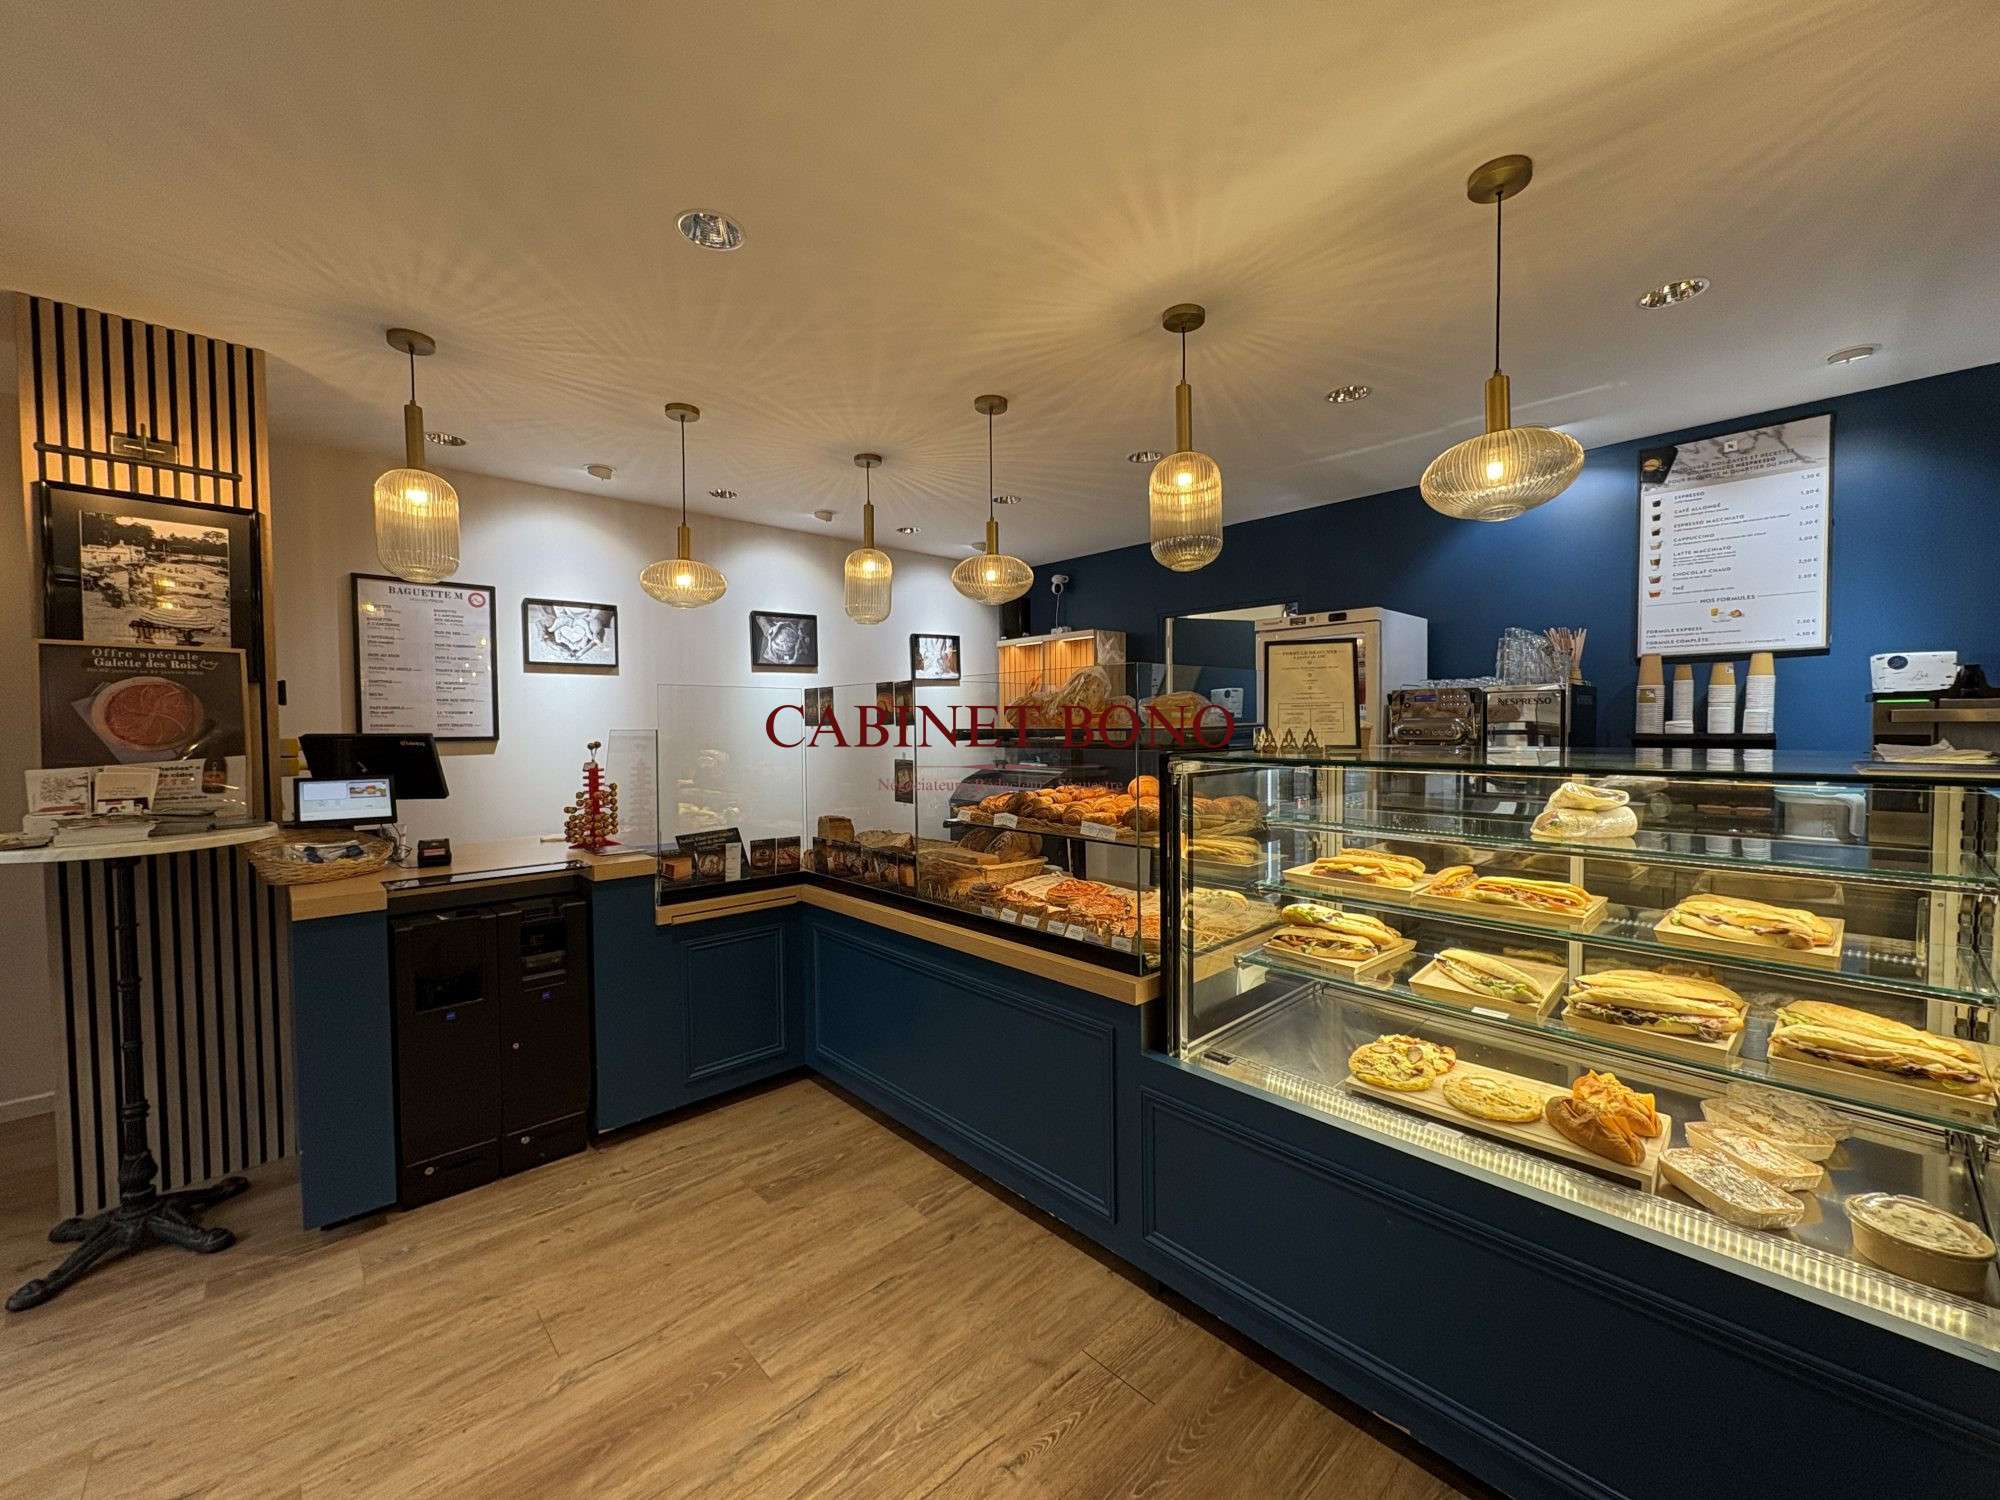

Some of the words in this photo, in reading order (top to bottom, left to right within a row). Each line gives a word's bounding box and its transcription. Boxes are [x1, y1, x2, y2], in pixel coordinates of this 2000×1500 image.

[388, 585, 452, 599] BAGUETTE
[454, 591, 463, 600] M
[92, 647, 133, 658] Offre
[140, 649, 199, 661] spéciale
[94, 657, 142, 668] Galette
[146, 659, 167, 668] des
[170, 660, 198, 669] Rois
[1497, 696, 1552, 705] NESPRESSO
